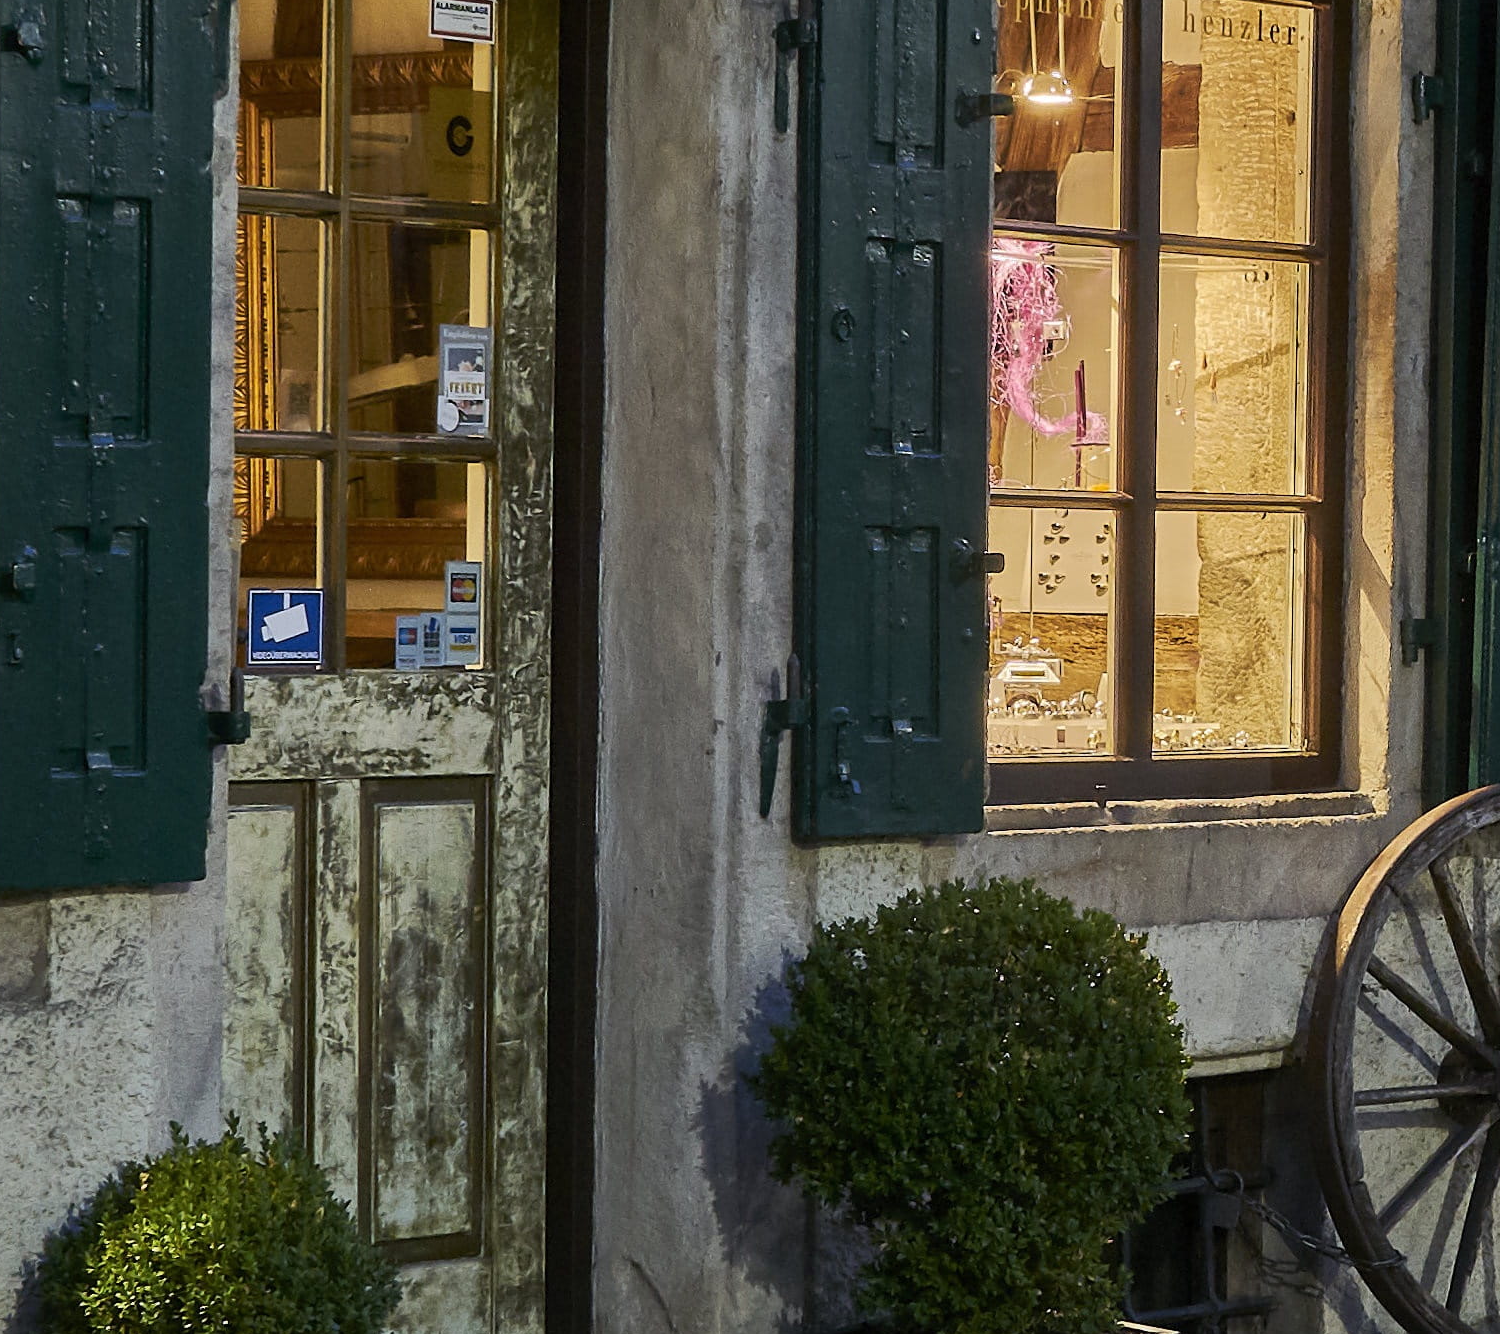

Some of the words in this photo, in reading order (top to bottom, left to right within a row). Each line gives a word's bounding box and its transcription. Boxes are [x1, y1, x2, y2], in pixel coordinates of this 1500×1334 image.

[435, 1, 489, 16] ALARMANLAGE
[1182, 0, 1297, 46] henzler
[454, 634, 472, 644] VISA
